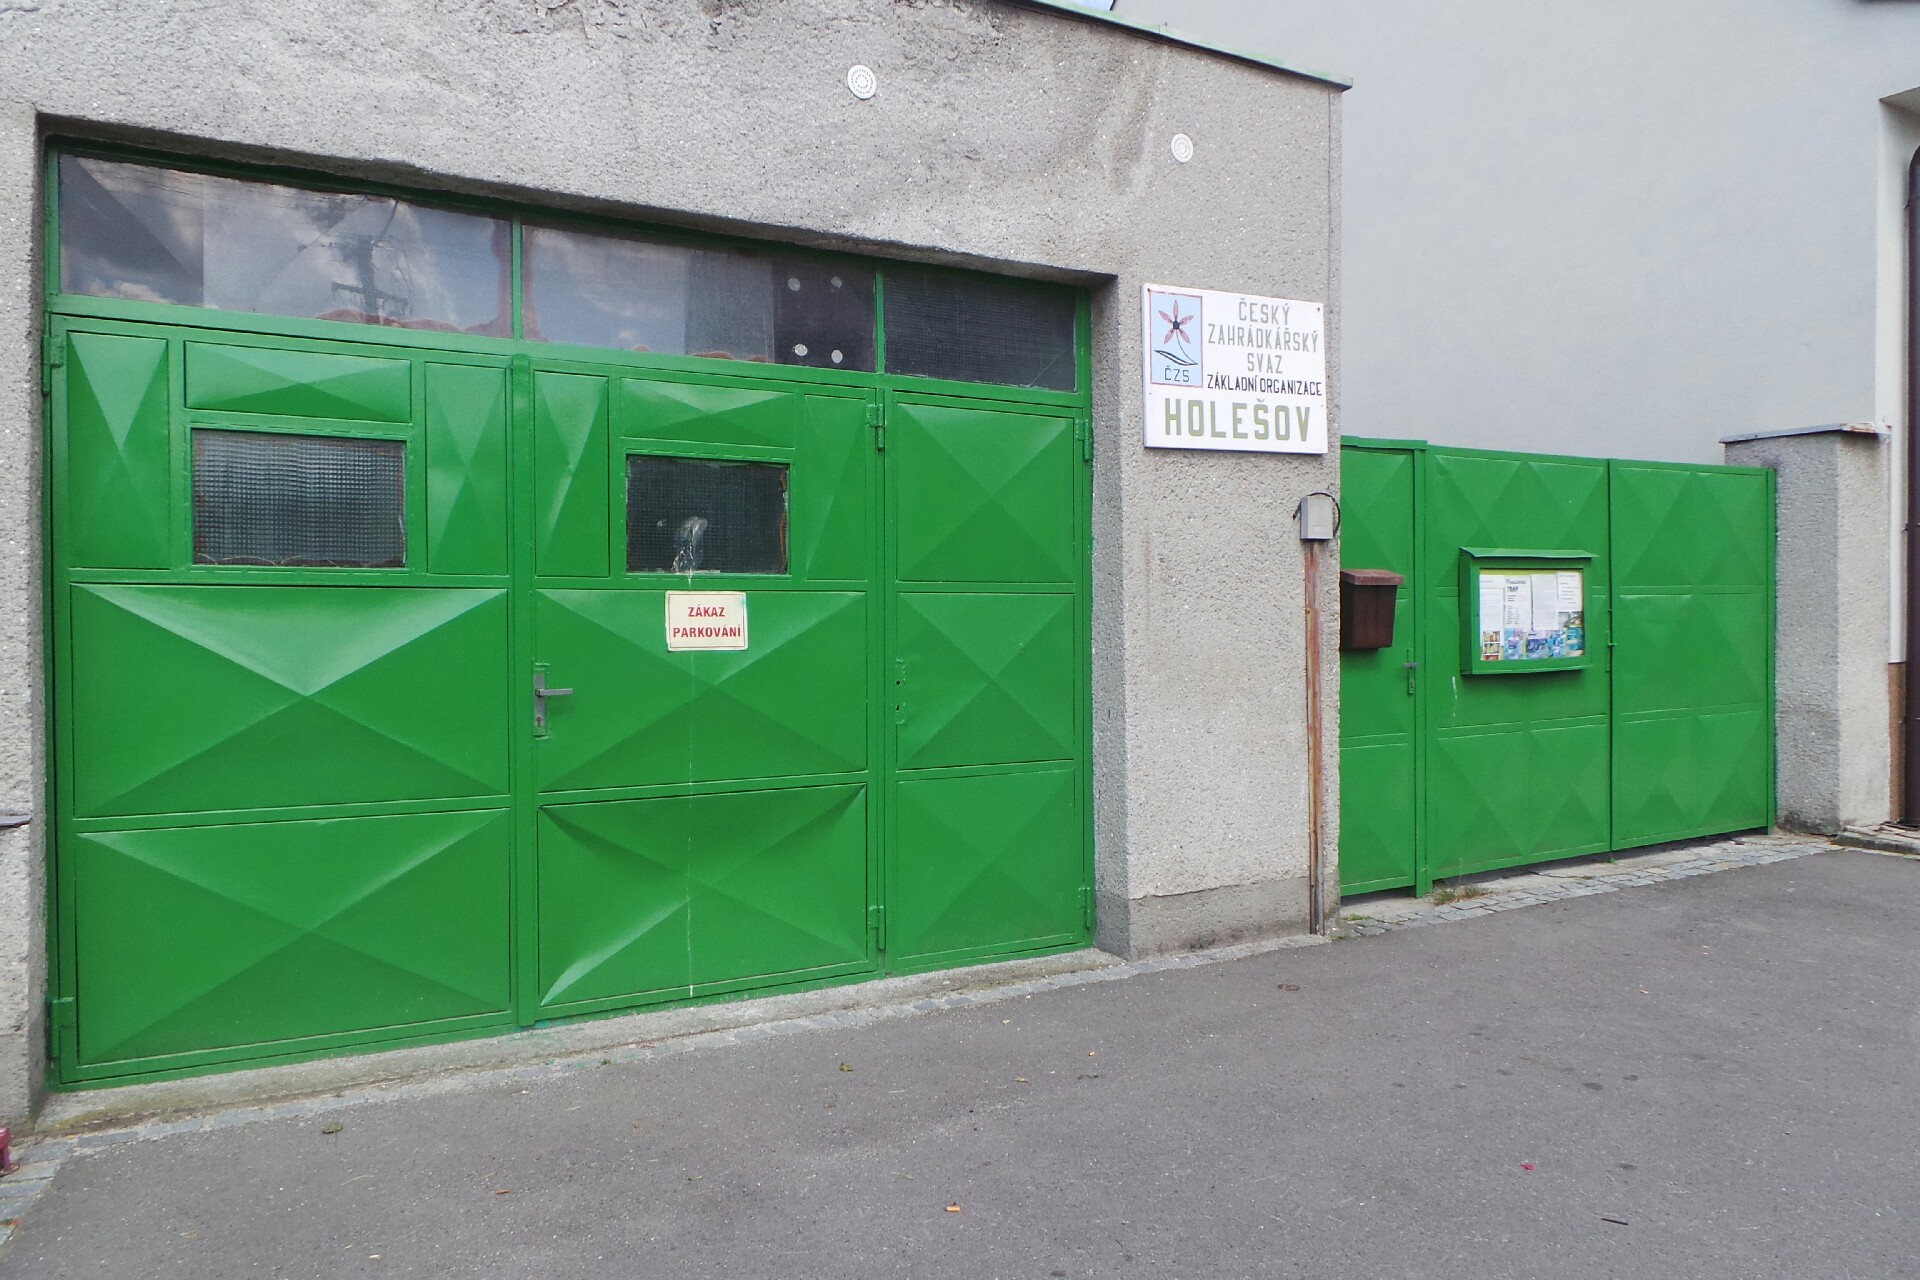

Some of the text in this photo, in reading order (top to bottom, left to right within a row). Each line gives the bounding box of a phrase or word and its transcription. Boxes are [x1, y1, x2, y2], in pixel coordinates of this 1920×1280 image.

[1238, 297, 1290, 326] ČESKÝ
[1207, 323, 1318, 353] ZAHRÁDKÁŘSKÝ
[1164, 365, 1190, 382] ČZS
[1247, 352, 1283, 374] SVAZ
[1207, 372, 1322, 396] ZÁKLADNÍ ORGANIZACE
[1164, 398, 1310, 442] HOLEŠOV
[688, 604, 726, 617] ZÁKAZ
[673, 624, 741, 638] PARKOVÁNÍ
